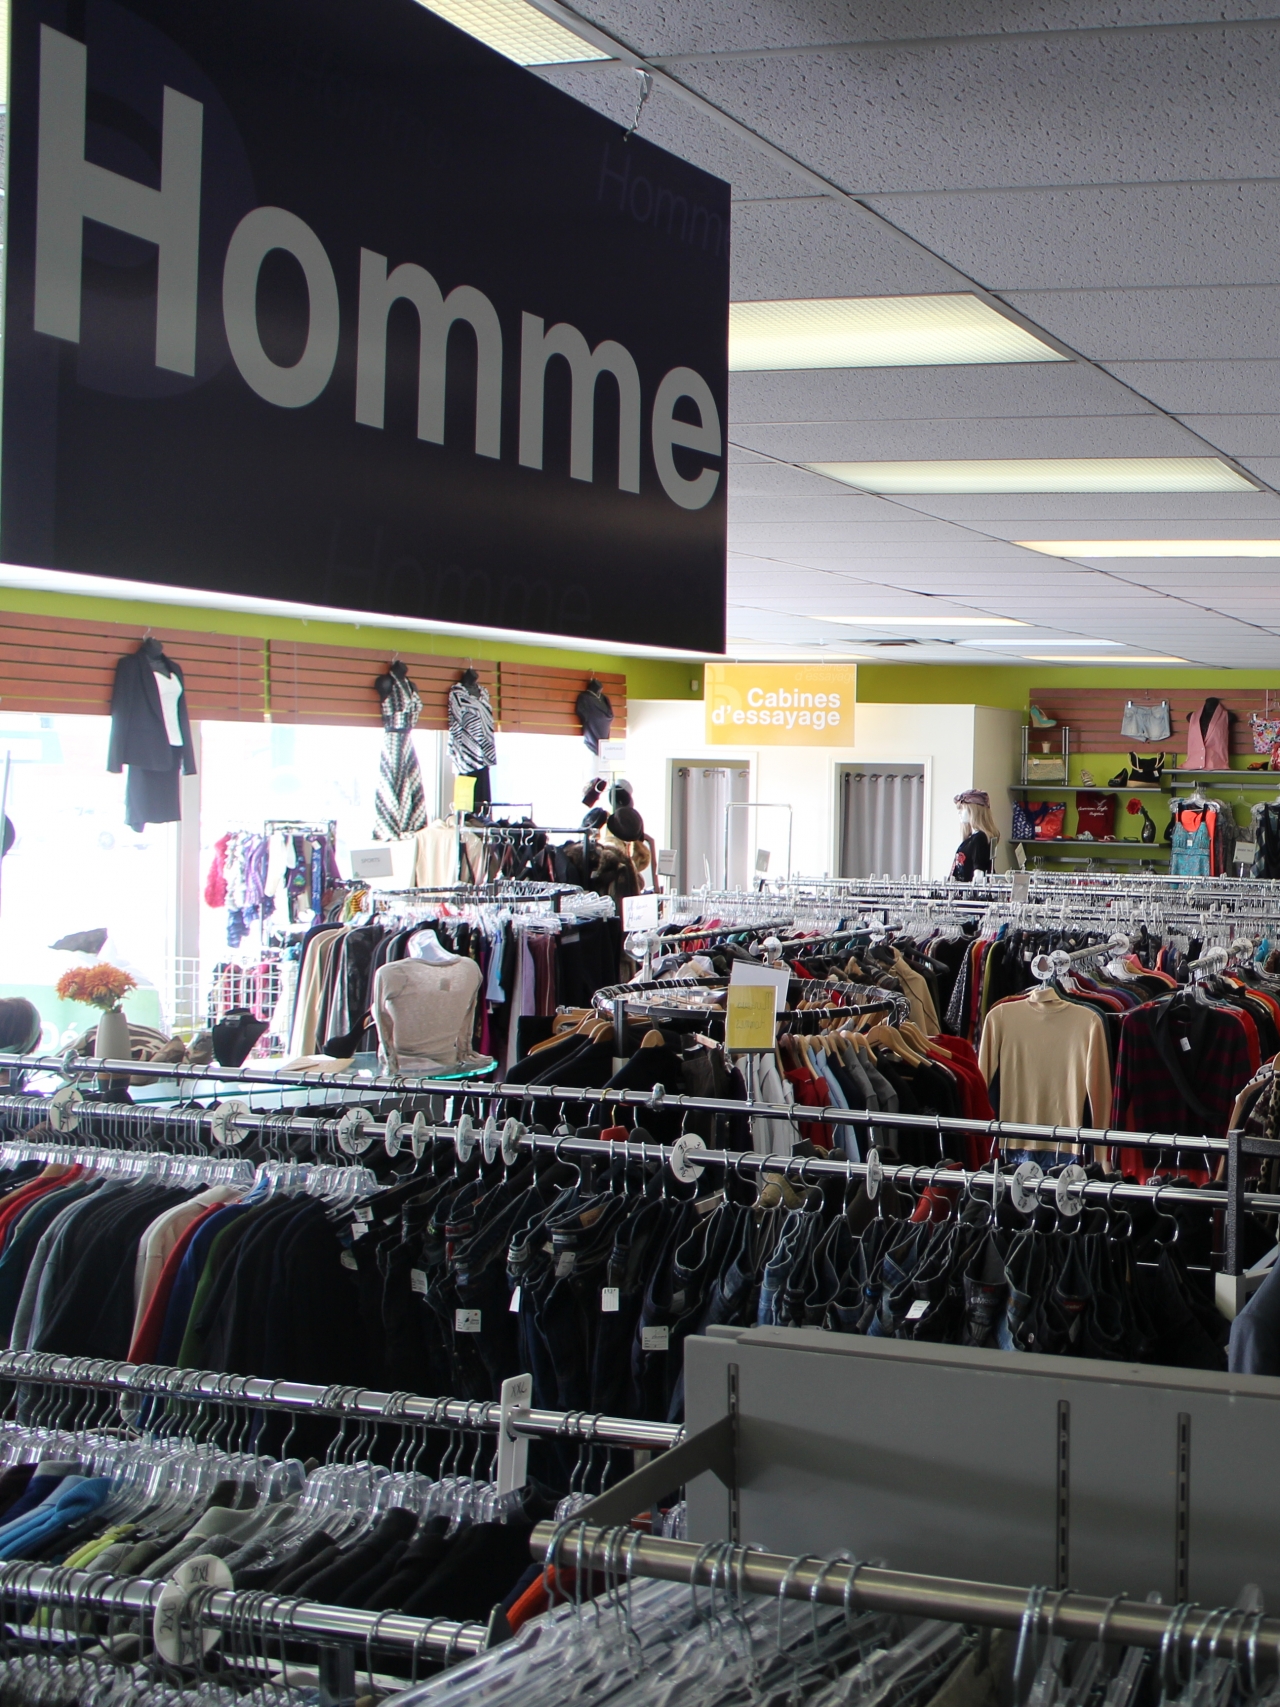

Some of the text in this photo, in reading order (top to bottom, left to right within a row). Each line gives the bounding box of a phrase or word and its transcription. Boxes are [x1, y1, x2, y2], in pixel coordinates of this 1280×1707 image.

[33, 23, 722, 510] Homme
[747, 687, 841, 708] Cabines
[711, 704, 841, 730] d'essayage
